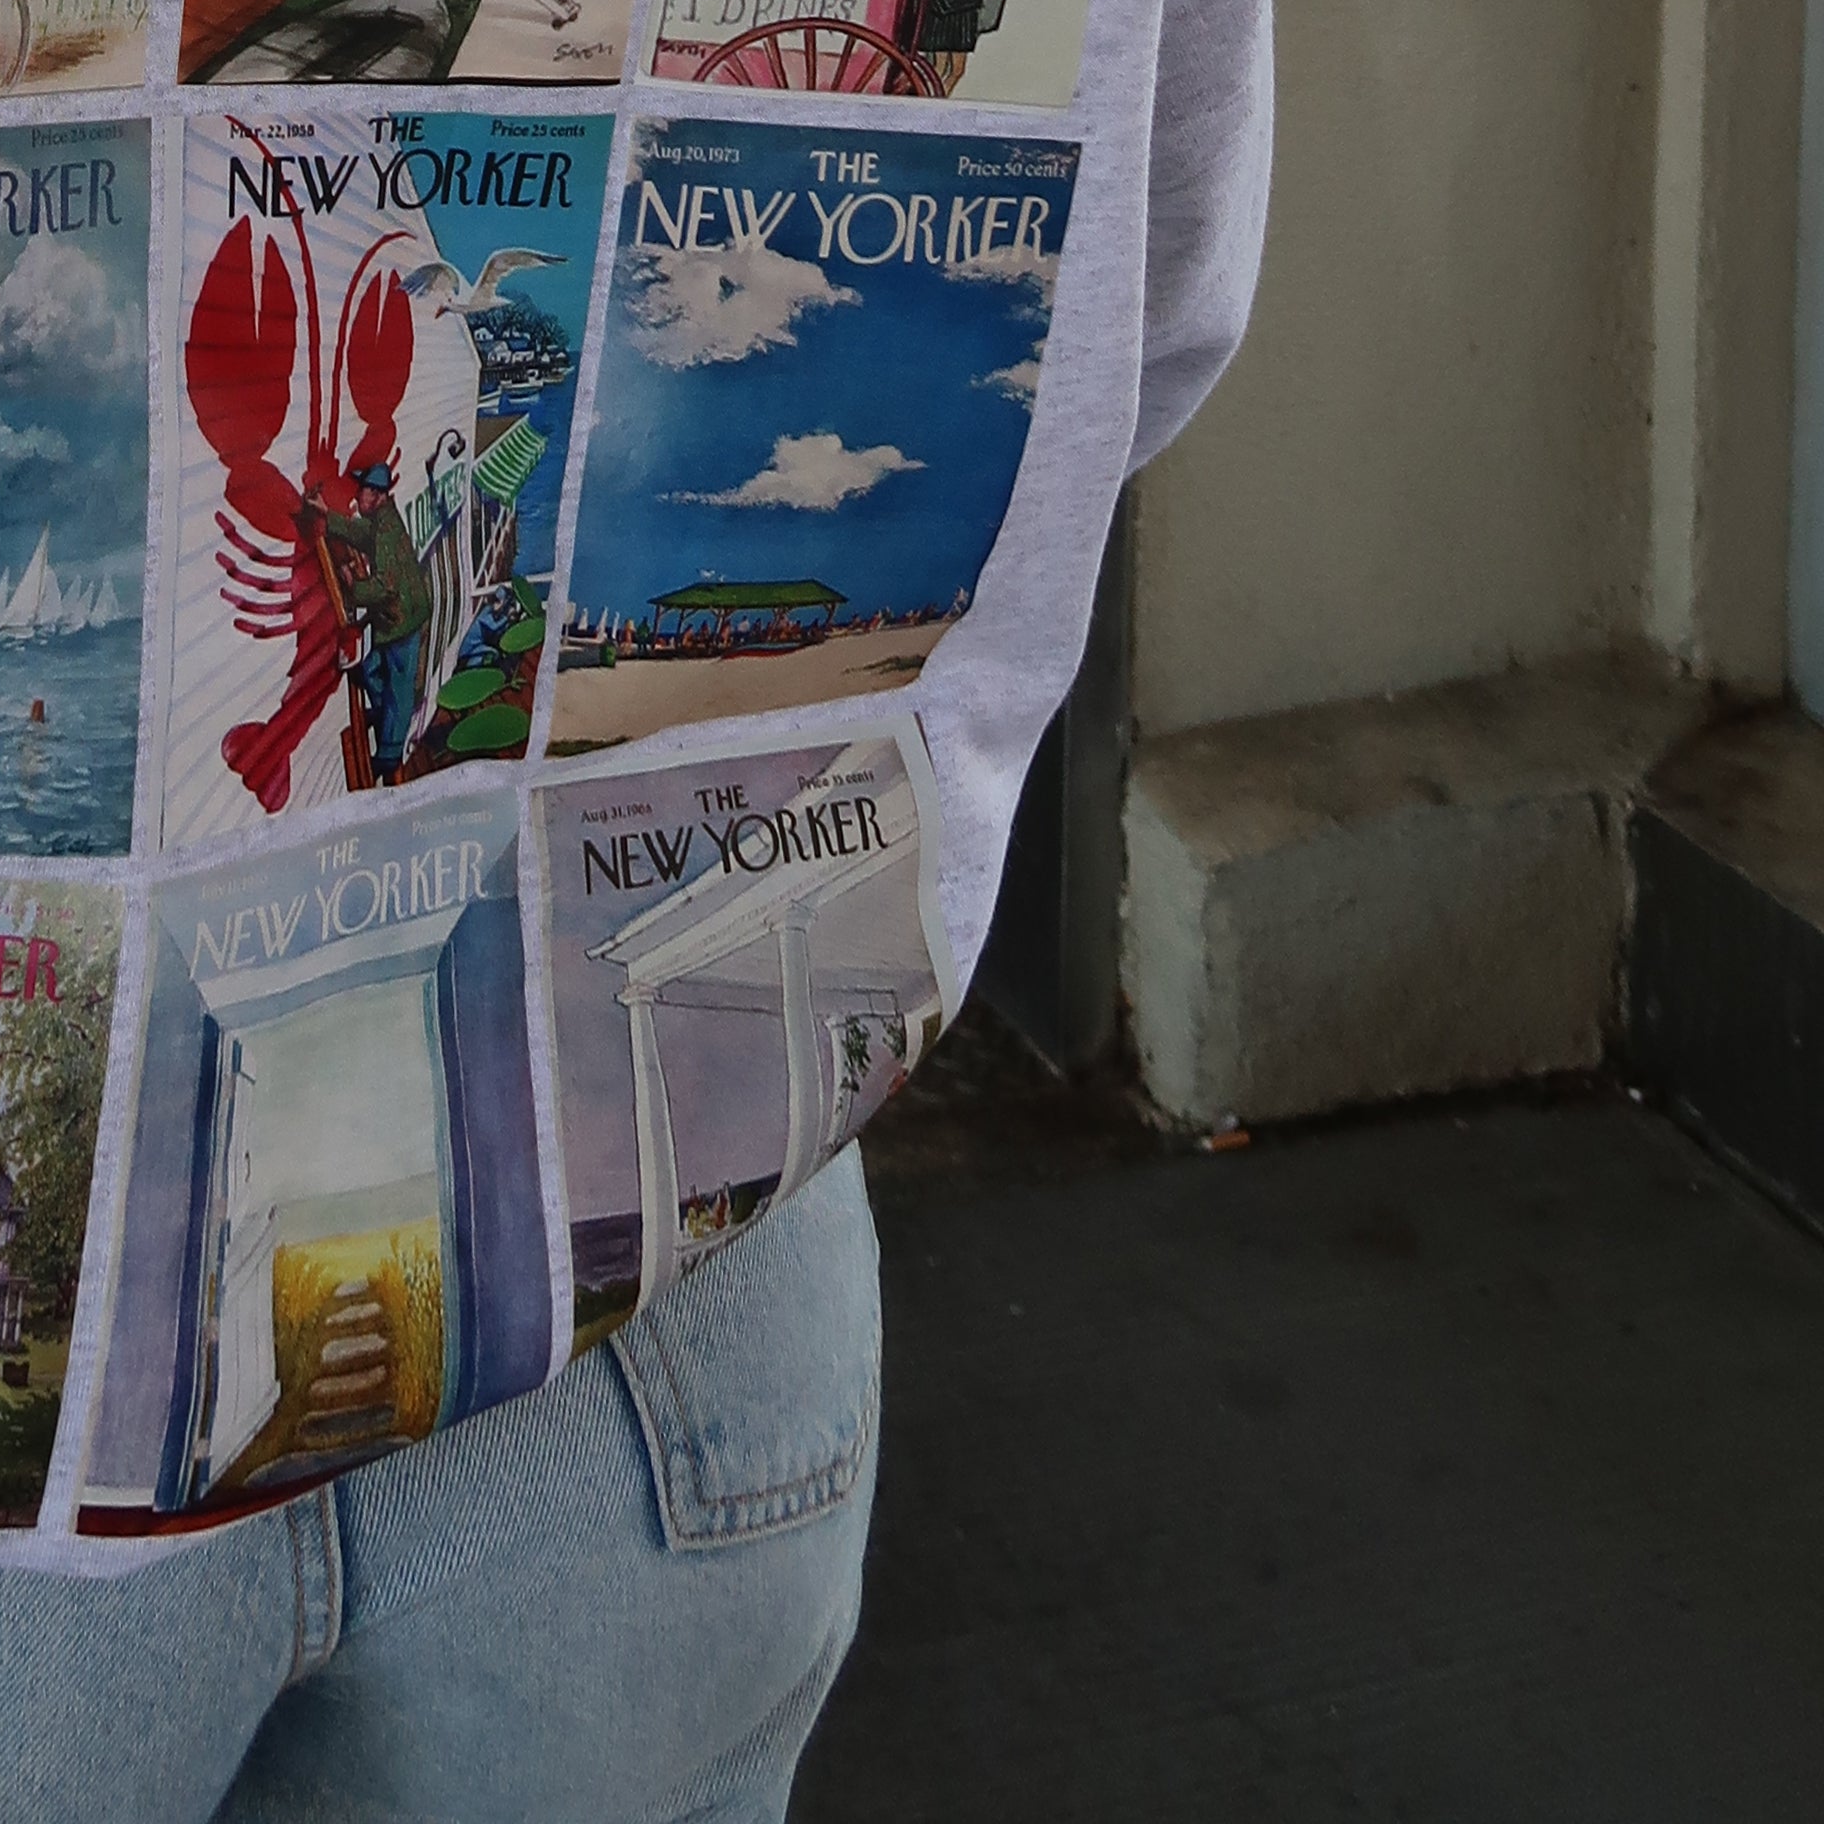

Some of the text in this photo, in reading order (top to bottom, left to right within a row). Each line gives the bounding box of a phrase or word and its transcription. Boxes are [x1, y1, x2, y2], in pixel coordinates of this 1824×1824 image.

[32, 127, 67, 148] Price
[368, 116, 425, 143] THE
[490, 120, 529, 137] Price
[550, 124, 585, 137] cents
[228, 147, 572, 219] NEW YORKER
[811, 150, 879, 184] THE
[958, 156, 1001, 176] Price
[1024, 160, 1067, 179] cents
[637, 180, 1050, 265] NEW YORKER
[694, 785, 750, 815] THE
[581, 809, 608, 824] Aug
[316, 837, 363, 875] THE
[582, 797, 888, 895] NEW YORKER
[190, 840, 488, 981] NEW YORKER
